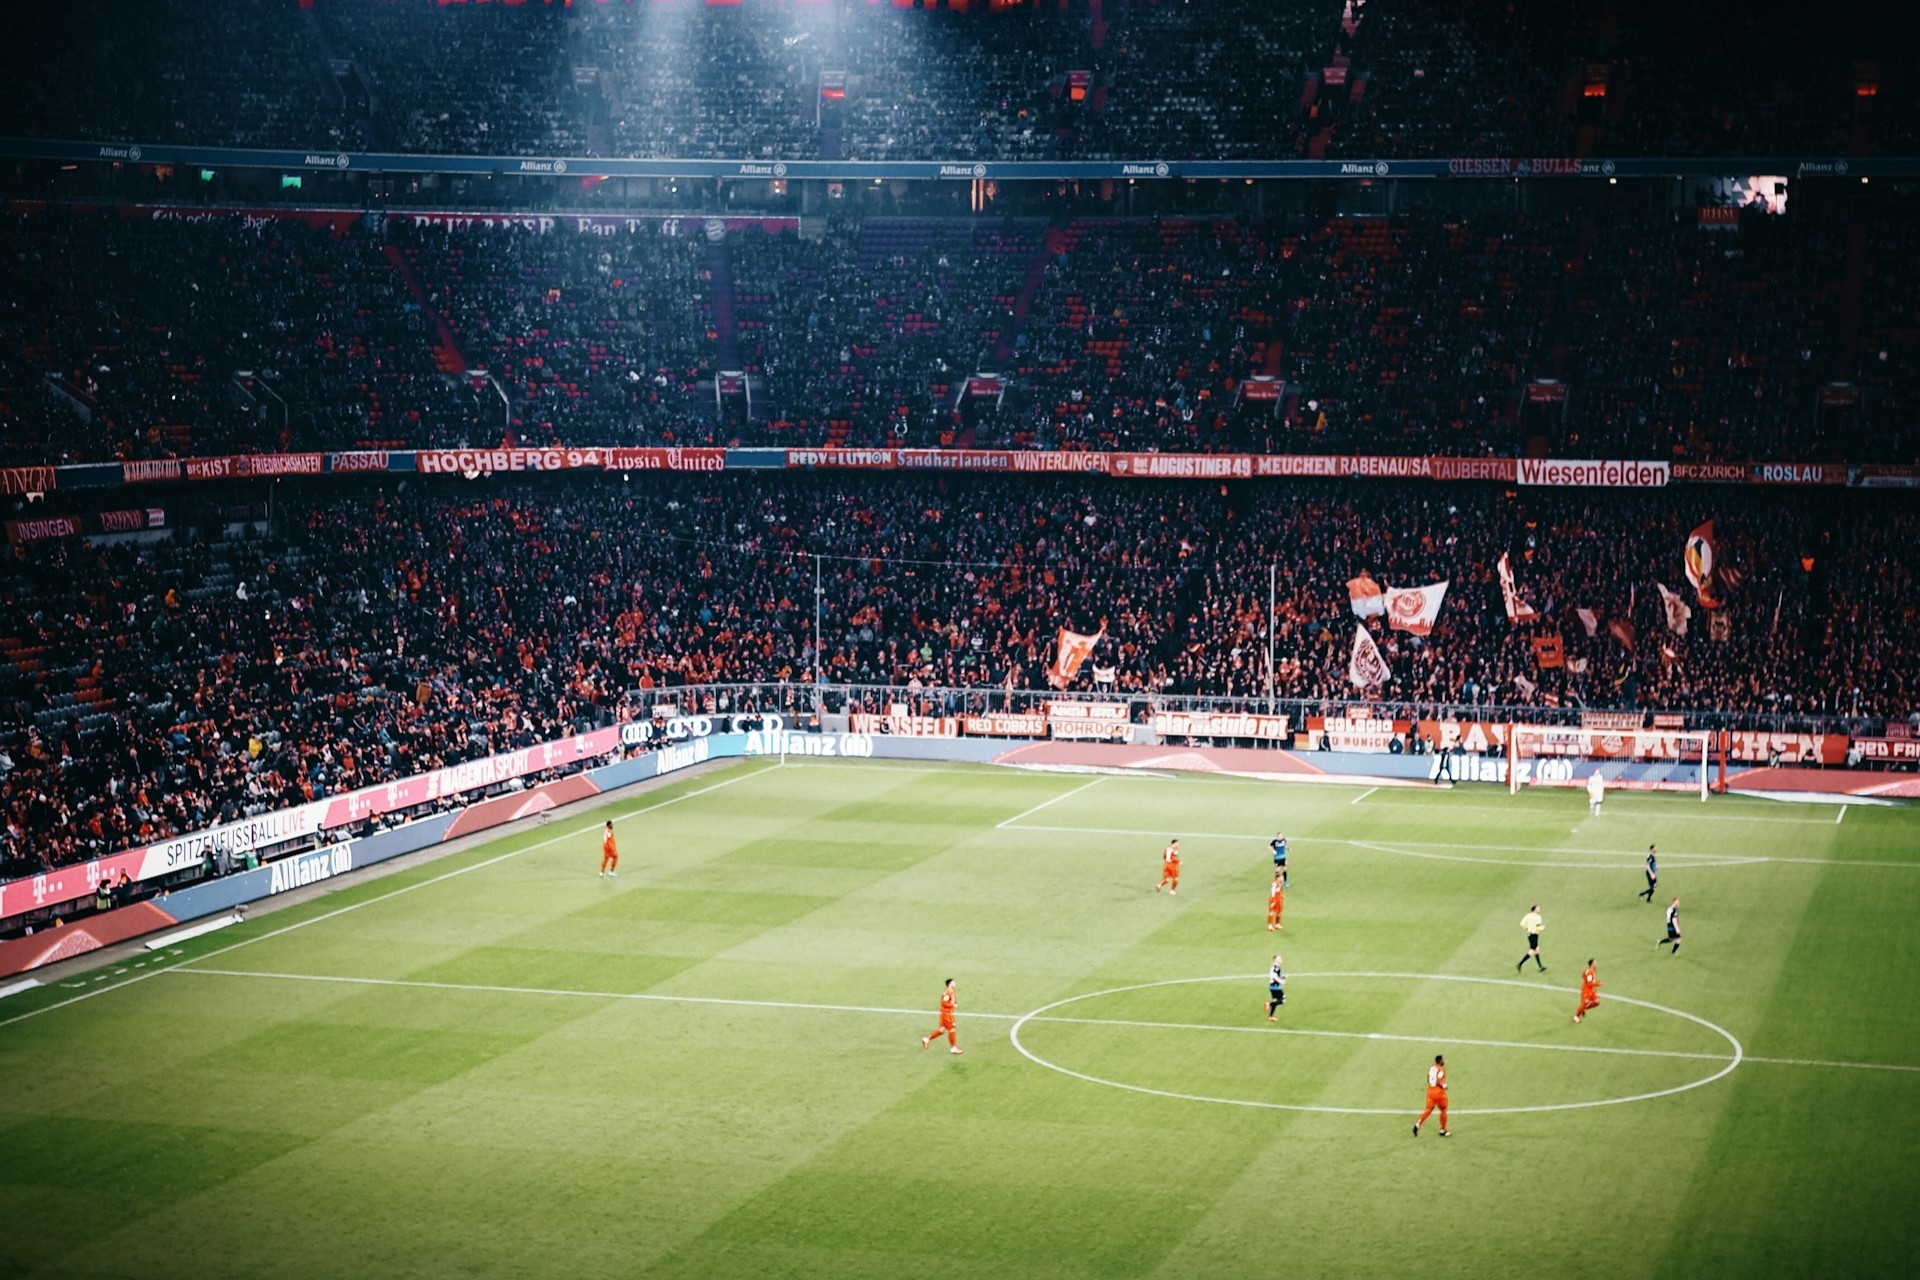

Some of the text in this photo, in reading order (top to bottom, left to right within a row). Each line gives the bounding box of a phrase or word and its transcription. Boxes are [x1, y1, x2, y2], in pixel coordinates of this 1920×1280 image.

[100, 147, 129, 158] Allianz
[305, 155, 335, 166] Allianz
[520, 161, 552, 172] Allianz
[740, 164, 772, 175] Allianz
[940, 165, 972, 176] Allianz
[1122, 164, 1155, 175] Allianz
[1341, 164, 1374, 174] Allianz
[1449, 157, 1511, 174] GIESSEN
[1532, 157, 1583, 174] BULLS
[1799, 162, 1833, 172] Allianz
[625, 218, 680, 237] Tff
[187, 459, 231, 476] BFC KIST
[250, 455, 322, 475] FRIEDRICHSHAFEN
[331, 451, 389, 471] PASSAU
[666, 448, 724, 471] United
[897, 450, 1008, 467] Sandharlanden
[1013, 452, 1110, 473] WINTERLINGEN
[1150, 457, 1231, 475] AUGUSTINER
[1232, 458, 1252, 477] 49
[1434, 460, 1516, 481] TAUBERTAL
[1521, 459, 1665, 486] Wiesenfelden
[1673, 465, 1698, 479] BFC
[1763, 465, 1823, 482] RÖSLAU
[17, 518, 75, 541] INSINGEN
[853, 714, 957, 737] WENSFELD
[968, 719, 1043, 734] RED COBRAS
[1258, 718, 1287, 739] rot
[744, 730, 837, 756] Allianz
[656, 743, 695, 775] Allianz
[440, 758, 497, 794] MAGENTA
[496, 750, 530, 780] SPORT
[282, 810, 306, 836] LIVE
[271, 855, 331, 895] Allianz
